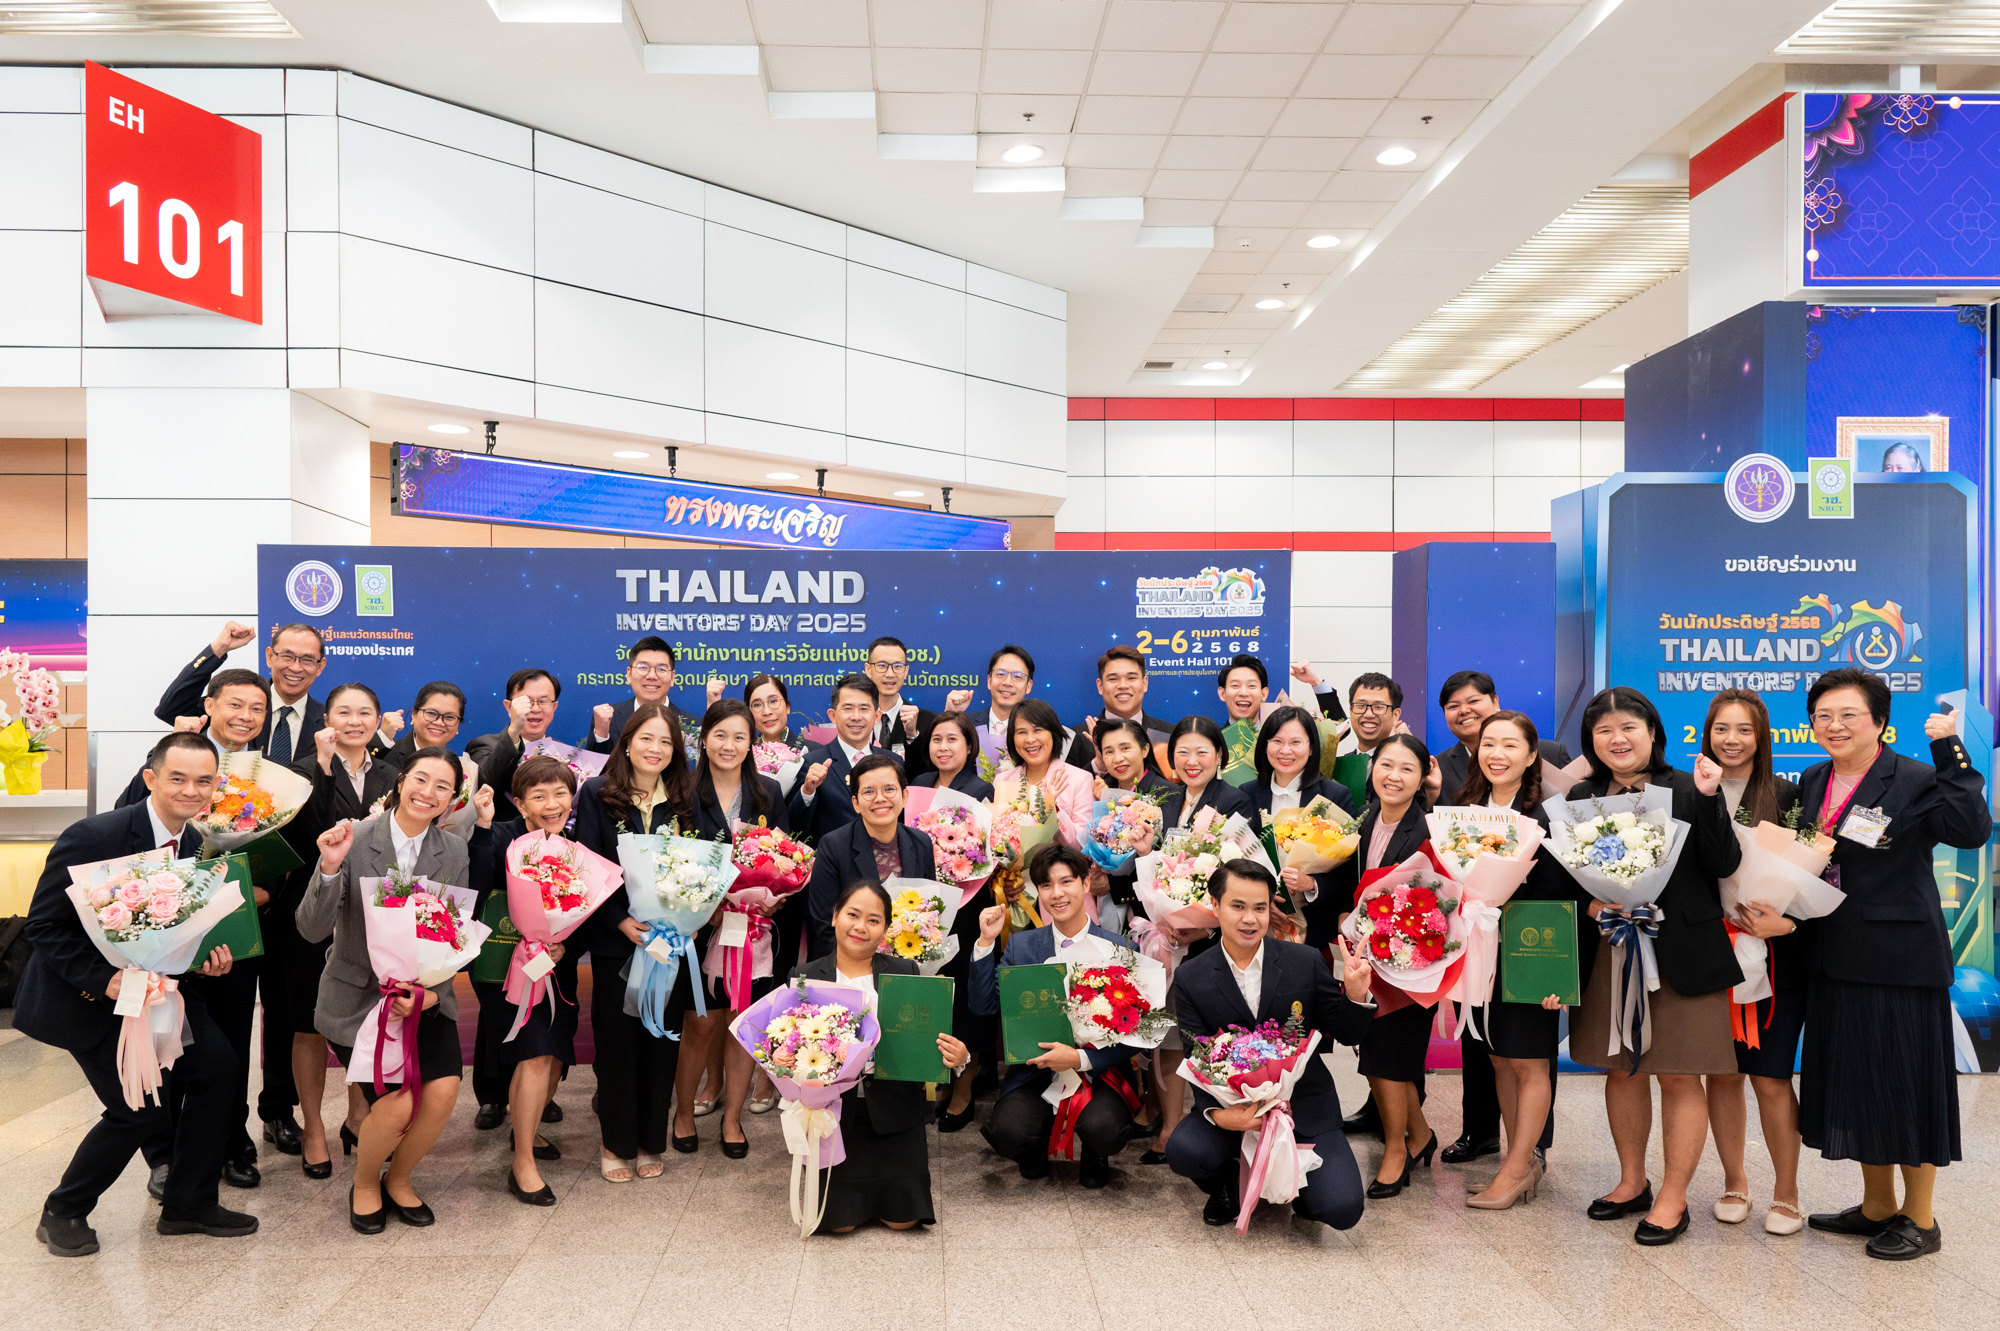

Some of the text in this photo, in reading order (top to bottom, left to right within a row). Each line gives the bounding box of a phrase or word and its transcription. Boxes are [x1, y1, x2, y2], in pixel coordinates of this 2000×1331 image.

[109, 96, 144, 134] EH
[108, 181, 244, 297] 101
[1821, 496, 1842, 504] วช.
[664, 494, 848, 547] ทรงพระเจริญ
[1724, 554, 1857, 573] ขอเชิญร่วมงาน
[615, 569, 865, 603] THAILAND
[1138, 590, 1214, 603] THAILAND
[1206, 606, 1228, 616] DAY
[1229, 605, 1262, 615] 2025
[749, 614, 793, 632] DAY
[797, 613, 867, 633] 2025
[1658, 613, 1821, 633] วันนักประดิษฐ์ 2568
[1191, 626, 1260, 641] กุมภาพันธ์
[1659, 638, 1822, 663] THAILAND
[1149, 657, 1184, 667] Event
[1187, 657, 1211, 666] Hall
[1438, 811, 1467, 820] LOVE
[1469, 813, 1477, 821] &
